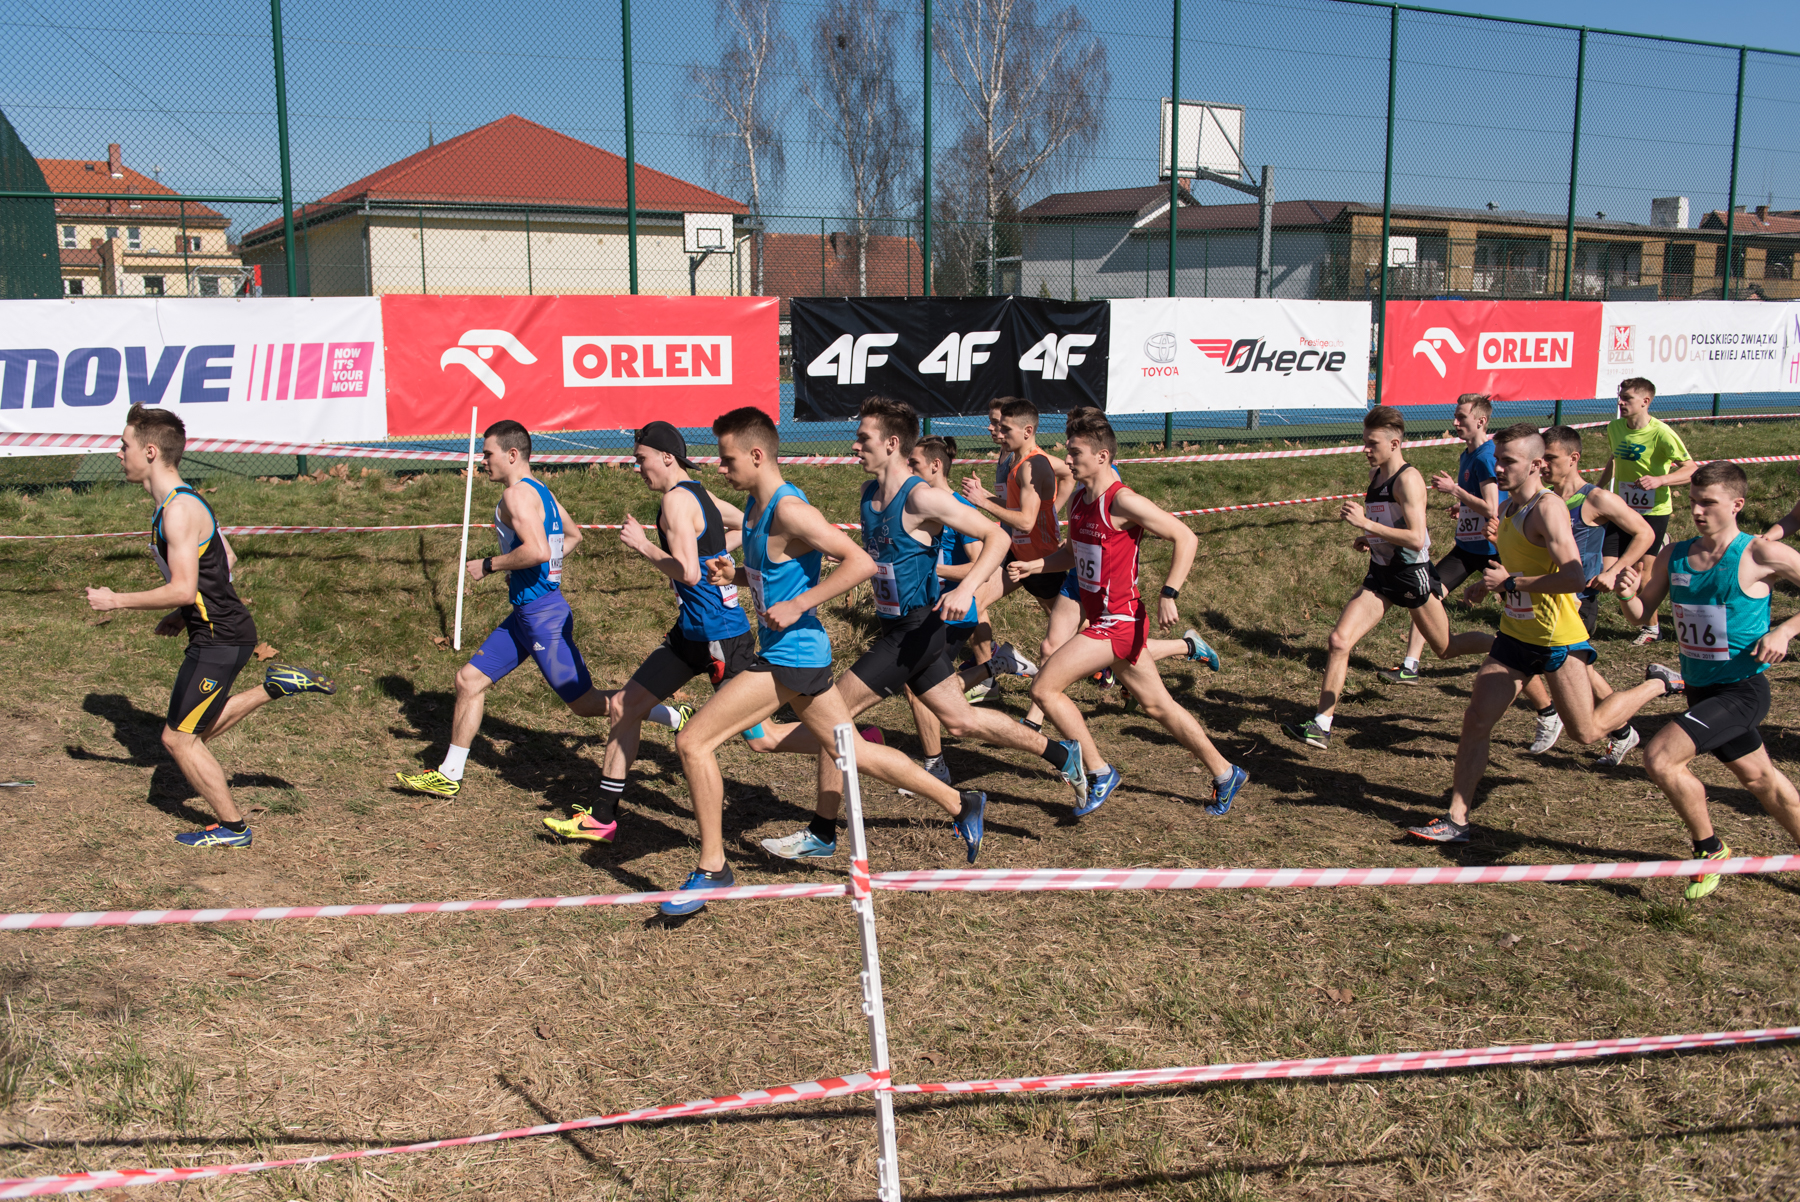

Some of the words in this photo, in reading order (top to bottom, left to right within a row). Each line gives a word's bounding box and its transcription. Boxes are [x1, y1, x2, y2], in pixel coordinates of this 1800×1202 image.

[1691, 333, 1739, 345] POLSKIEGO
[334, 348, 361, 359] NOW
[1483, 338, 1568, 363] ORLEN
[1648, 334, 1688, 363] 100
[573, 343, 721, 379] ORLEN
[807, 333, 899, 384] 4F
[918, 330, 1001, 382] 4F
[1018, 332, 1097, 380] 4F
[1609, 351, 1633, 363] PZLA
[1690, 350, 1707, 361] LAT
[333, 359, 354, 370] IT'S
[332, 370, 363, 381] YOUR
[1141, 366, 1179, 377] TOYOA
[331, 381, 363, 392] MOVE
[1624, 492, 1649, 505] 166
[1459, 517, 1479, 532] 387
[1678, 621, 1716, 647] 216
